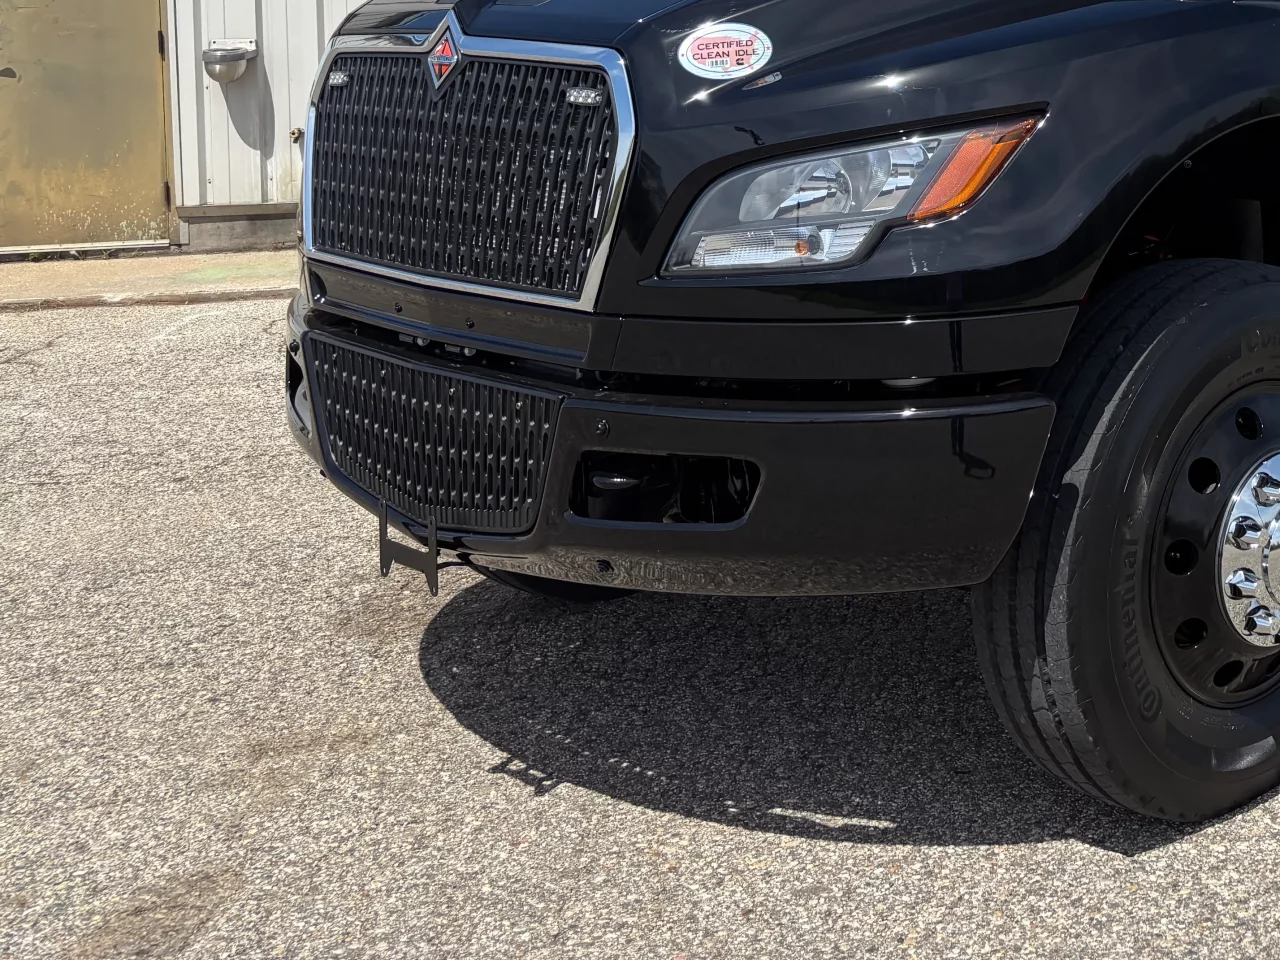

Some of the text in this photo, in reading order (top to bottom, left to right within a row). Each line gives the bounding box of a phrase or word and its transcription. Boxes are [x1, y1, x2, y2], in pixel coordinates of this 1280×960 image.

[697, 39, 754, 51] CERTIFIED
[692, 48, 760, 61] CLEAN IDLE
